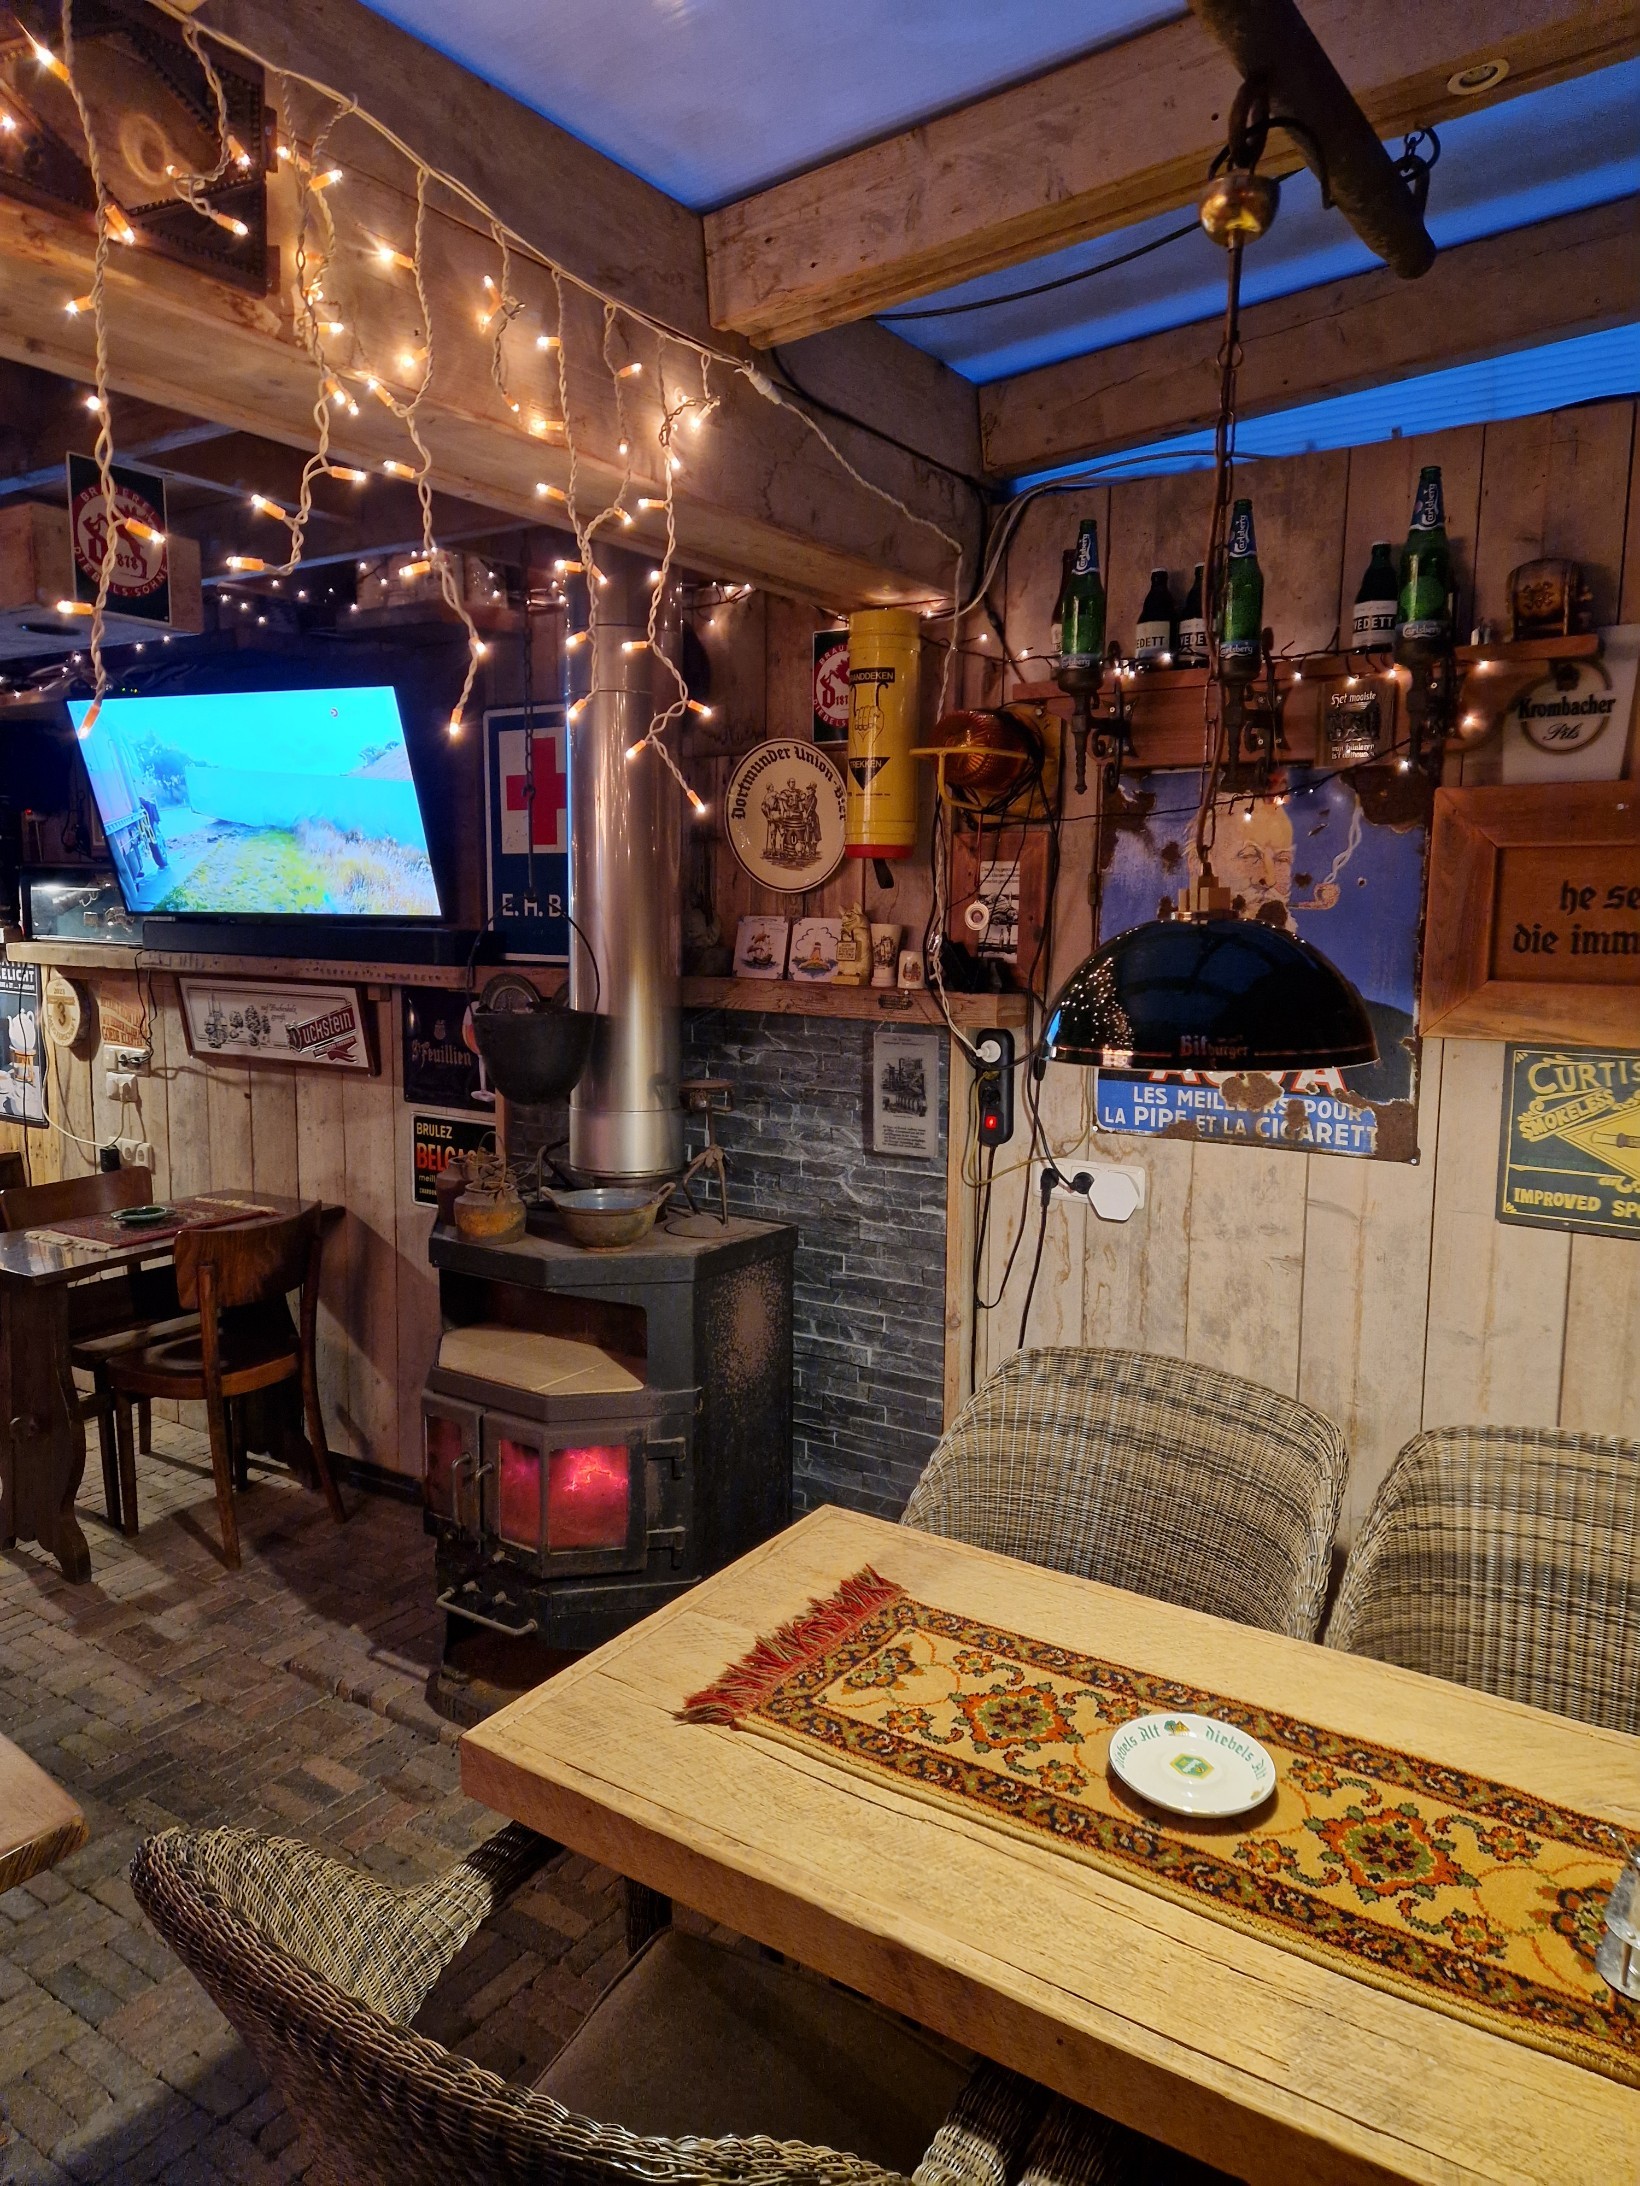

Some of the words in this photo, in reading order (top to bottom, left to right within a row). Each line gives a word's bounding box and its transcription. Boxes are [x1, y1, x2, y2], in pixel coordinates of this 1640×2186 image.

[1421, 482, 1439, 526] Carlsberg
[1234, 514, 1250, 553] Carlsberg
[114, 553, 139, 571] 878
[1076, 533, 1091, 571] Carlsberg
[1402, 623, 1441, 639] Carlsberg
[1517, 694, 1617, 719] Krombacher
[1543, 722, 1583, 741] Pils
[731, 747, 791, 820] Dortmunder
[1513, 922, 1560, 955] die
[0, 967, 35, 983] ELICHT
[57, 1001, 67, 1027] 3
[1133, 1085, 1168, 1105] LES
[1177, 1089, 1288, 1114] MEILRS
[1304, 1099, 1362, 1122] POUR
[1519, 1088, 1616, 1140] SMOKELESS
[416, 1122, 453, 1139] BRULEZ
[1105, 1106, 1126, 1124] LA
[1196, 1114, 1217, 1133] ET
[1223, 1117, 1247, 1136] LA
[1513, 1187, 1602, 1212] IMPROVED
[1137, 1723, 1161, 1742] Alt
[1205, 1724, 1255, 1762] Diebels
